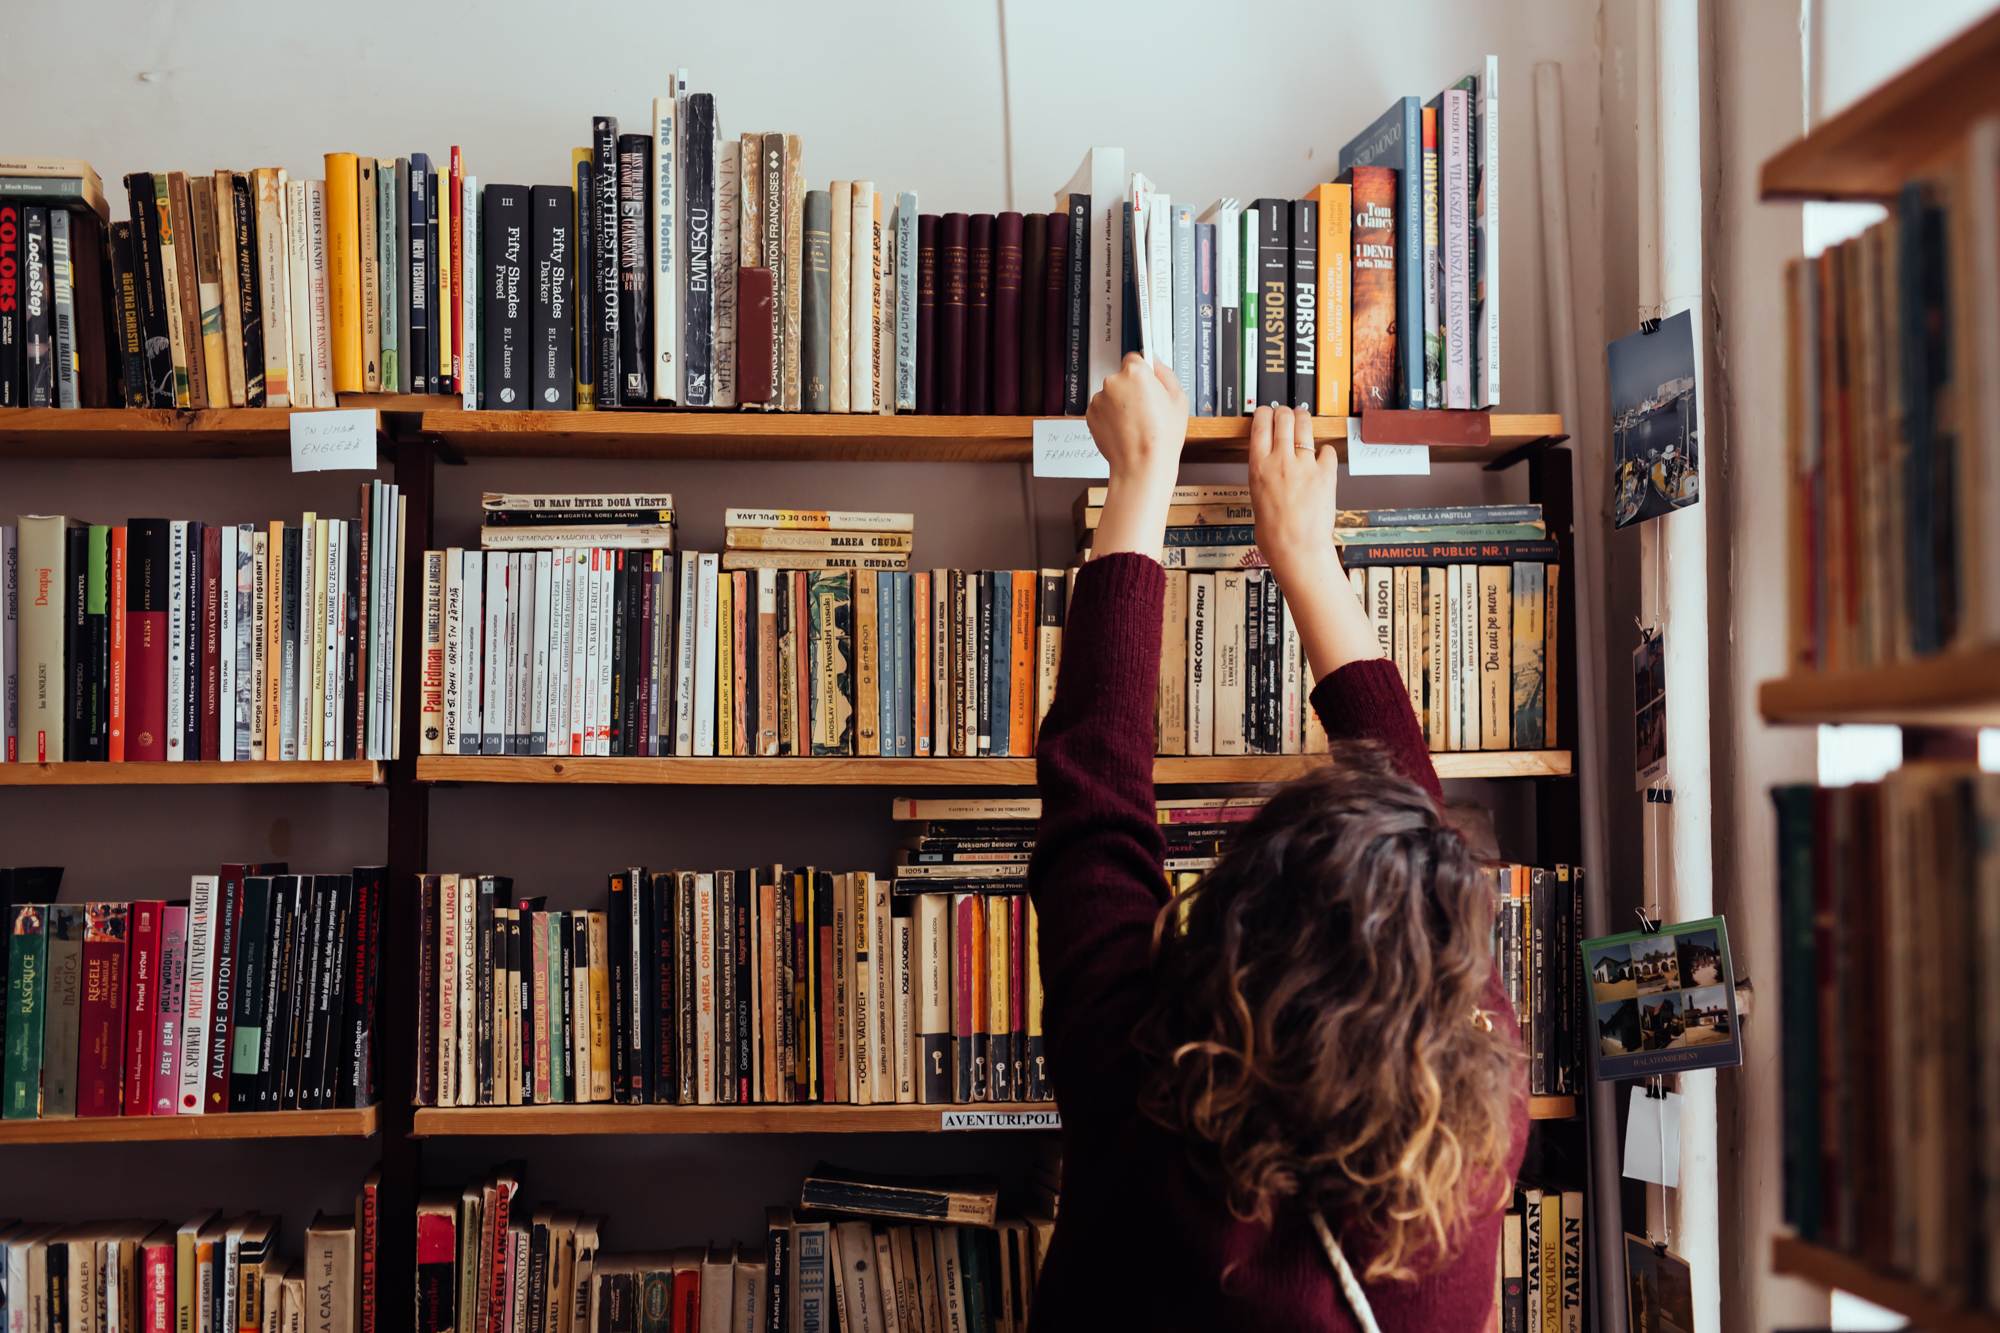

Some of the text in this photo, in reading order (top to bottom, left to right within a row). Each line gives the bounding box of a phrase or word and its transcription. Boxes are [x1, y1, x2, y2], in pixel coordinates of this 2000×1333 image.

[661, 118, 672, 273] The Twelve Months
[770, 172, 779, 246] FRANÇAISES
[1367, 203, 1392, 218] Tom
[1425, 152, 1438, 246] DINOSAURI
[240, 225, 248, 246] Man
[603, 135, 618, 332] The FARTHEST SHORE
[1074, 218, 1083, 256] MINOTAURE
[1357, 214, 1394, 232] Clancy
[1449, 95, 1464, 366] BENEDEK ELEK VILÁGSZÉP NÁDSZÁL KISASSZONY
[0, 207, 16, 312] COLORS
[28, 232, 42, 317] LockeStep
[53, 237, 70, 304] FIT TO KILL
[241, 249, 251, 297] Invisible
[412, 239, 425, 309] NEW TESTAMENT
[506, 227, 520, 319] Fifty Shades
[550, 227, 564, 319] Fifty Shades
[691, 209, 708, 292] EMINESCU
[1074, 259, 1082, 271] DU
[1357, 258, 1392, 269] della TIGRE
[1363, 245, 1393, 258] DENTI
[313, 190, 327, 369] CHARLES HANDY THE EMPTY RAINCOAT
[367, 279, 372, 288] BY
[496, 265, 505, 300] Freed
[540, 261, 550, 304] Darker
[1073, 273, 1081, 326] RENDEZ-VOUS
[59, 314, 69, 341] BRETT
[1265, 282, 1285, 373] FORSYTH
[1296, 283, 1315, 375] FORSYTH
[1335, 303, 1343, 357] DELL'IMPERO
[60, 343, 71, 383] HALLIDAY
[503, 328, 511, 379] EL James
[548, 328, 556, 379] EL James
[533, 496, 667, 508] UN NAIV ÎNTRE DOUĂ VÎRSTE
[173, 524, 182, 600] SĂLBATIC
[831, 536, 903, 547] MAREA CRUDĂ
[1369, 547, 1509, 558] INAMICUL PUBLIC NR. 1
[35, 568, 52, 606] Derapaj
[329, 584, 336, 596] CU
[328, 598, 336, 625] MAXIME
[1194, 586, 1205, 684] LEAC COTRA FRICII
[1486, 585, 1501, 673] Doi ani pe mare
[424, 649, 442, 713] Paul Erdman
[1288, 662, 1296, 672] jos
[1289, 673, 1294, 683] Pe
[640, 701, 648, 743] Marguerite
[857, 879, 865, 912] VILLIERS
[858, 914, 865, 922] de
[356, 887, 368, 1004] AVENTURA IRANIANĂ
[443, 884, 455, 1027] NOAPTEA CEA MAI LUNGĂ
[702, 891, 711, 1012] MAREA CONFRUNTARE
[14, 979, 21, 989] LA
[88, 959, 100, 1002] REGELE
[213, 957, 231, 1078] ALAIN DE BOTTON
[354, 1021, 362, 1058] Ciobotea
[161, 1022, 174, 1075] ZOEY DEAN
[740, 1039, 748, 1071] Georges
[1633, 1052, 1699, 1067] BALATONBERÉNY
[364, 1193, 374, 1266] LANCELOT
[519, 1235, 528, 1265] DOYLE
[1529, 1203, 1540, 1295] TARZAN
[324, 1261, 332, 1277] vol.
[774, 1236, 782, 1276] BORGIA
[1565, 1217, 1580, 1310] TARZAN
[81, 1261, 89, 1313] CAVALER
[156, 1263, 165, 1330] JEFFREY ARCHER
[517, 1266, 526, 1301] CONAN
[575, 1280, 588, 1321] Talida
